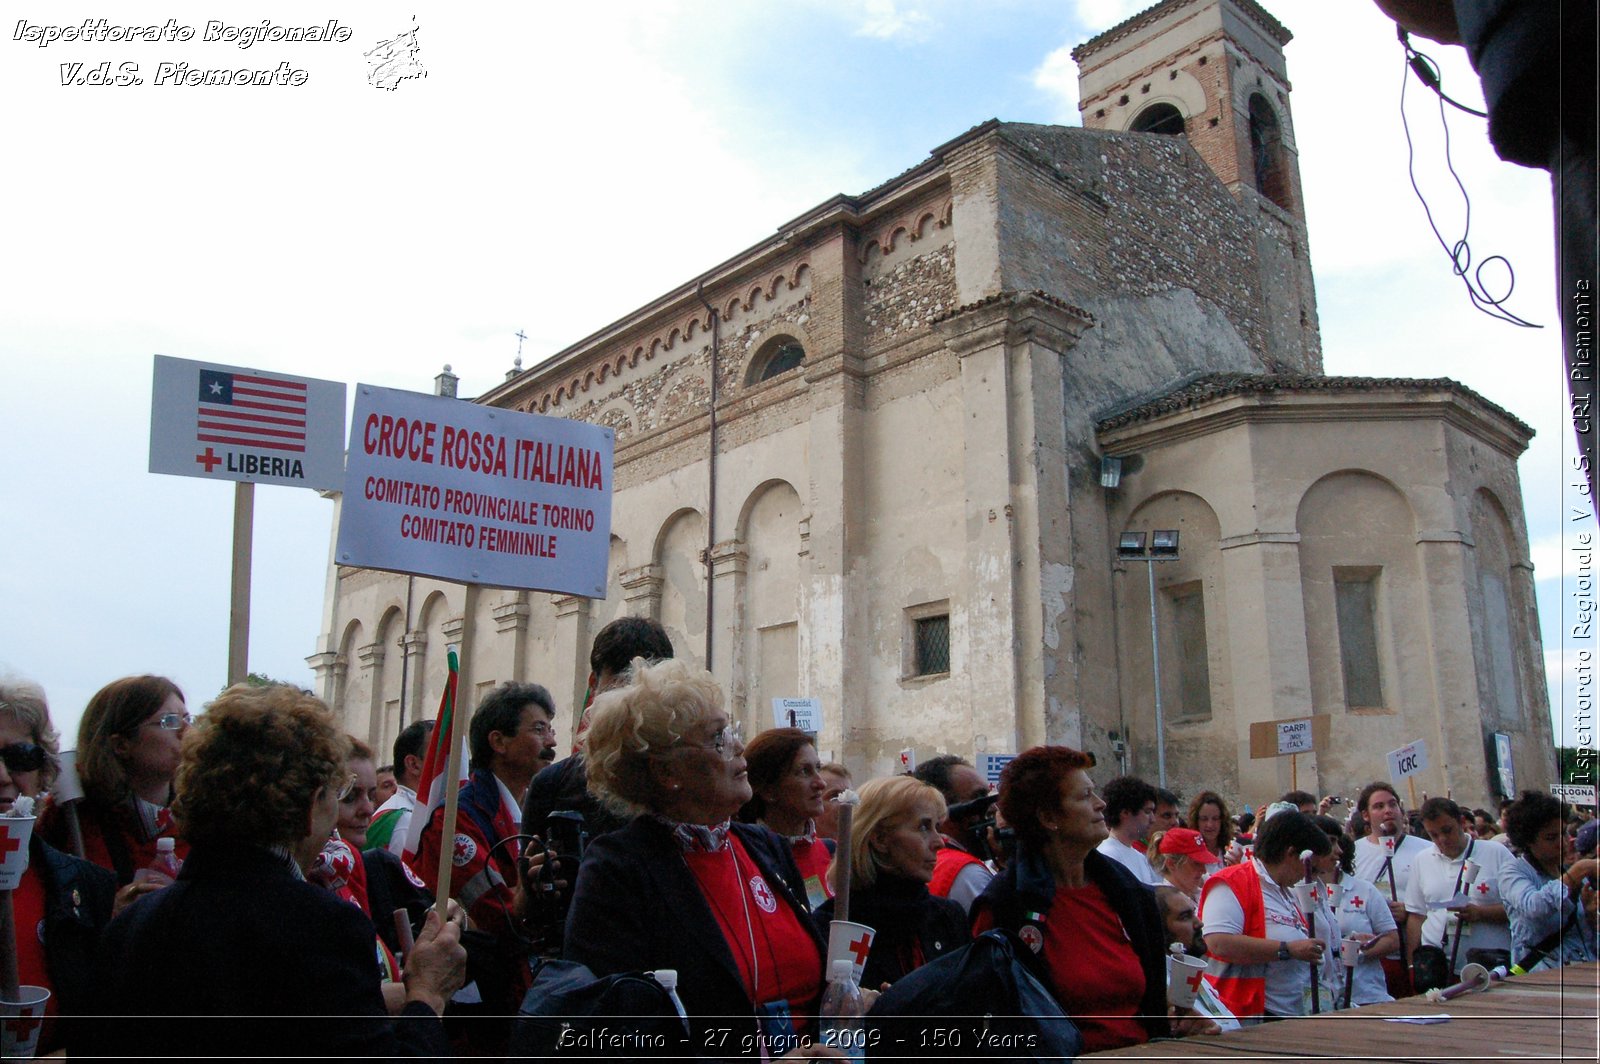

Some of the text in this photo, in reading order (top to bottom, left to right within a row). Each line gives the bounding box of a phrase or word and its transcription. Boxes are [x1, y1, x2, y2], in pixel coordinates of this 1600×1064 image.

[364, 413, 602, 491] CROCE ROSSA ITALIANA
[227, 452, 304, 479] LIBERIA
[365, 476, 594, 532] COMITATO PROVINCIALE TORINO
[401, 514, 557, 558] COMITATO FEMMINILE
[1283, 723, 1306, 733] CARPI
[1286, 740, 1304, 749] ITALY
[1398, 753, 1418, 775] ICRC
[1551, 788, 1594, 796] BOLOGNA
